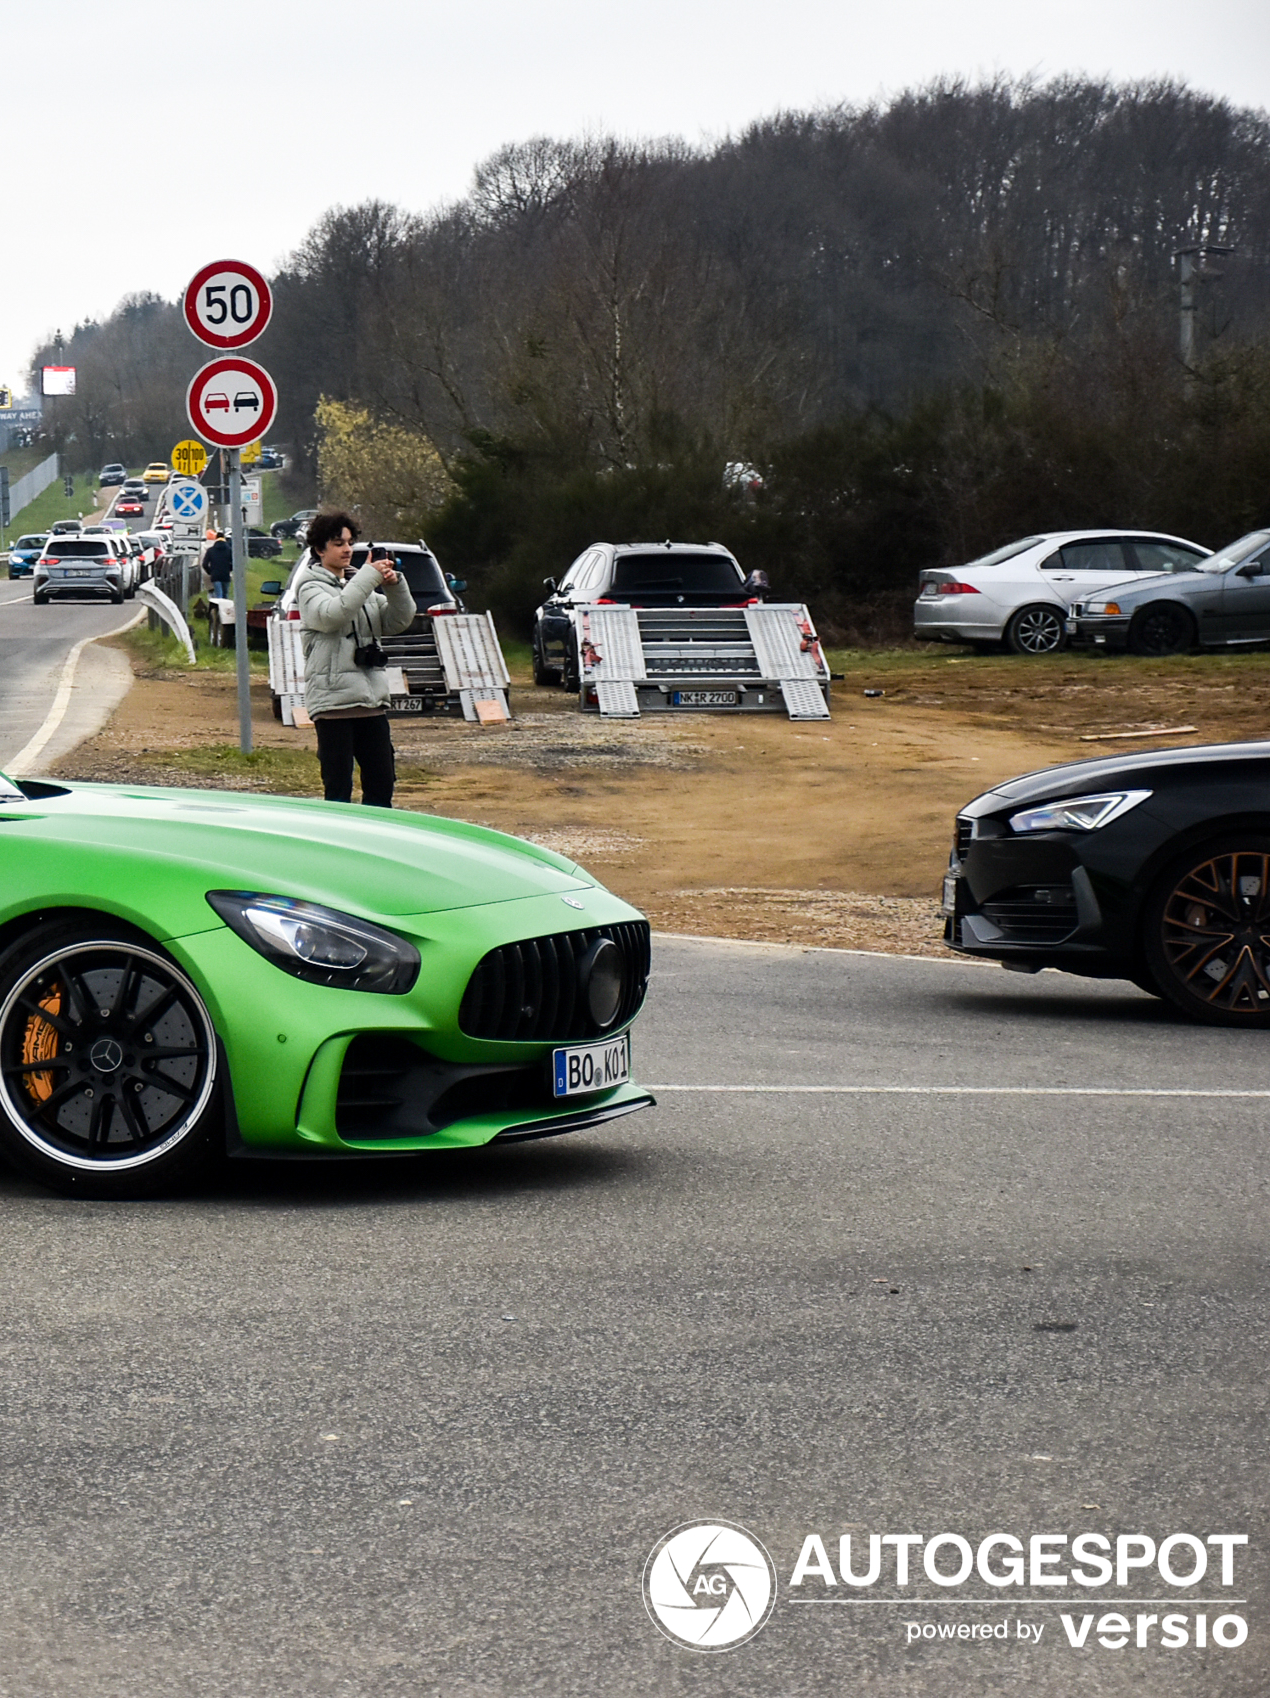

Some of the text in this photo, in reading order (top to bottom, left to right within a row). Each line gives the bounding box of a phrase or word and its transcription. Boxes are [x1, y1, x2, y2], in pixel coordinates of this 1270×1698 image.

[205, 284, 253, 325] 50
[0, 412, 18, 420] WAY
[175, 448, 188, 461] 30
[190, 448, 204, 461] 100
[680, 692, 694, 703] NK
[700, 692, 707, 703] R
[709, 692, 735, 703] 2700
[404, 700, 421, 710] 267
[568, 1053, 594, 1089] BO
